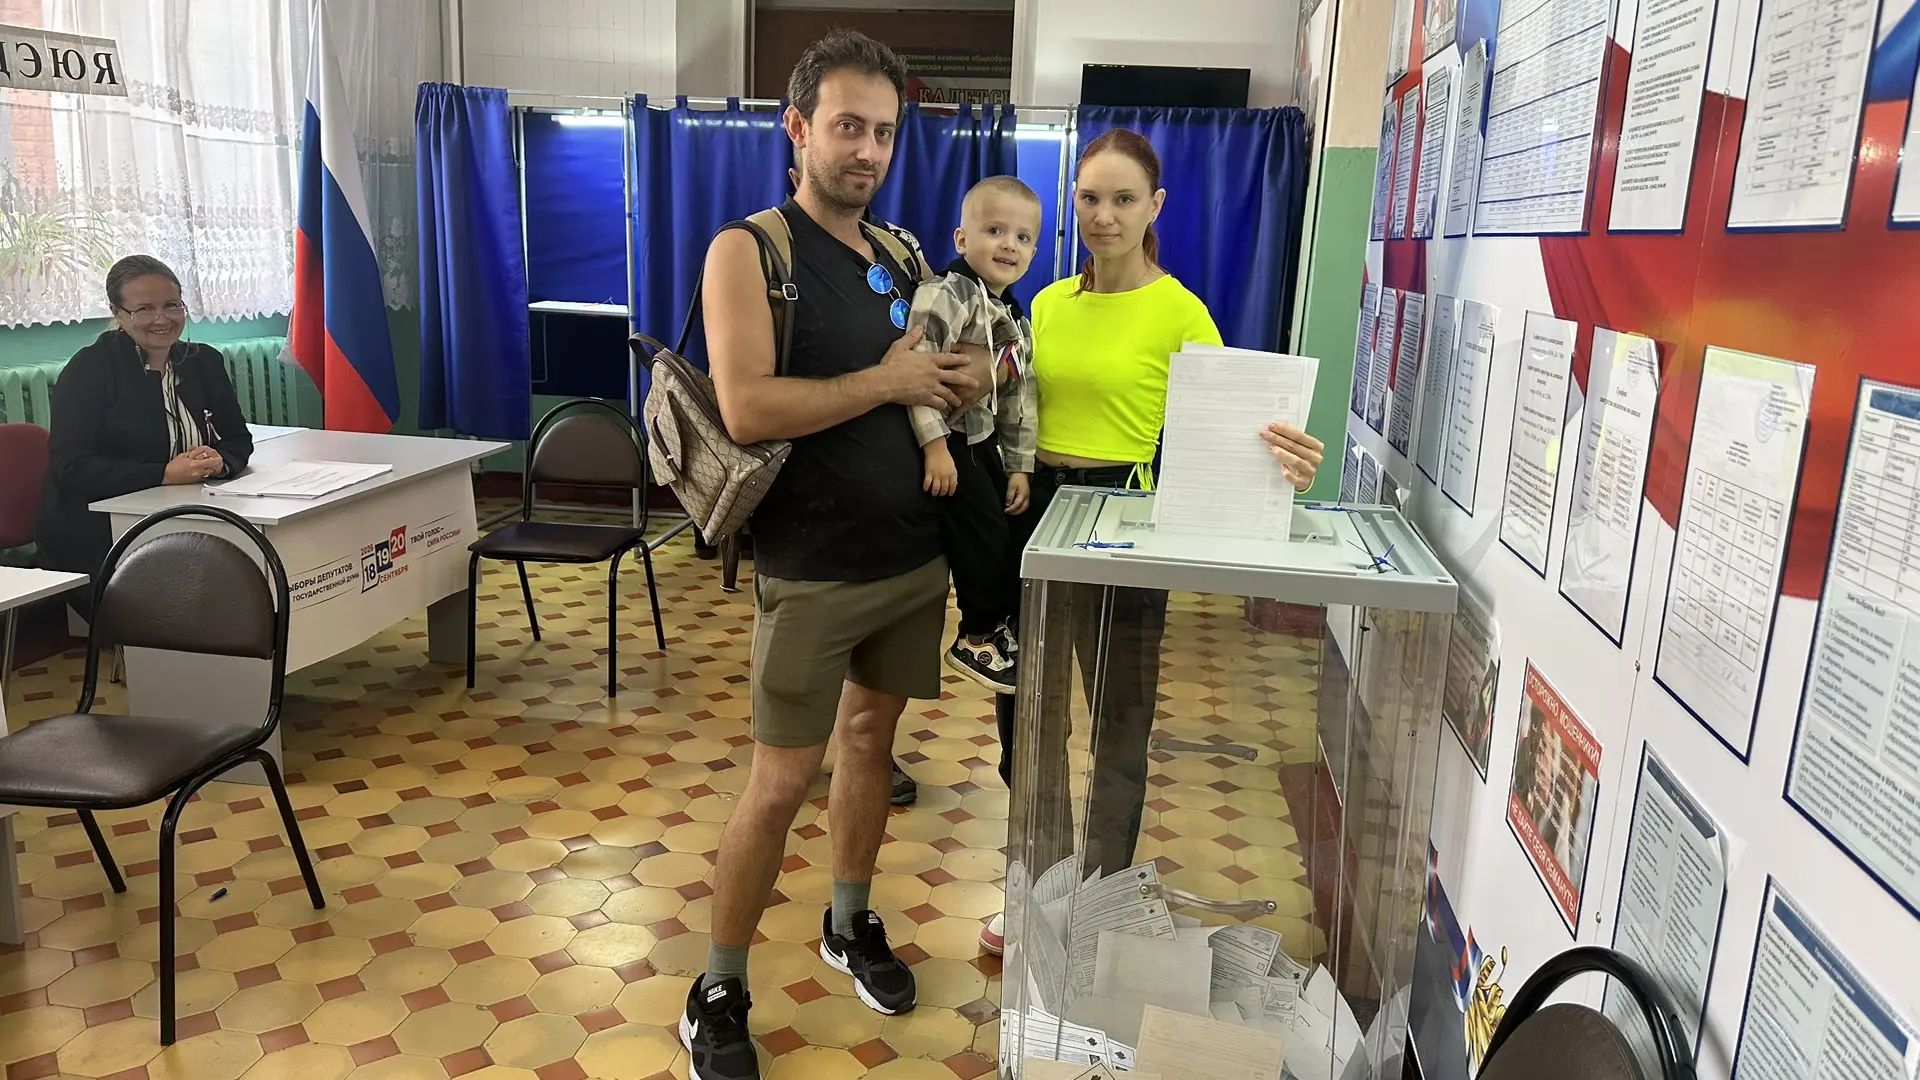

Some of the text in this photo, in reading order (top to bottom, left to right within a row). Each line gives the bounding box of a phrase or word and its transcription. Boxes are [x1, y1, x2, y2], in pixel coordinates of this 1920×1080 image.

[391, 533, 404, 552] 20
[410, 531, 424, 544] ТВОЙ
[377, 548, 389, 566] 19
[289, 562, 353, 592] ЫБОРЫ ДЕПУТАТОВ
[365, 563, 377, 582] 18
[380, 565, 408, 583] СЕНТЯБРЯ
[292, 577, 347, 602] ГОСУДАРСТВЕННОЙ
[1516, 805, 1534, 846] ДАЙТЕ
[1531, 831, 1547, 867] СЕБЯ
[1543, 852, 1576, 918] ОБМАНУТЬ!
[708, 985, 722, 996] NIKE
